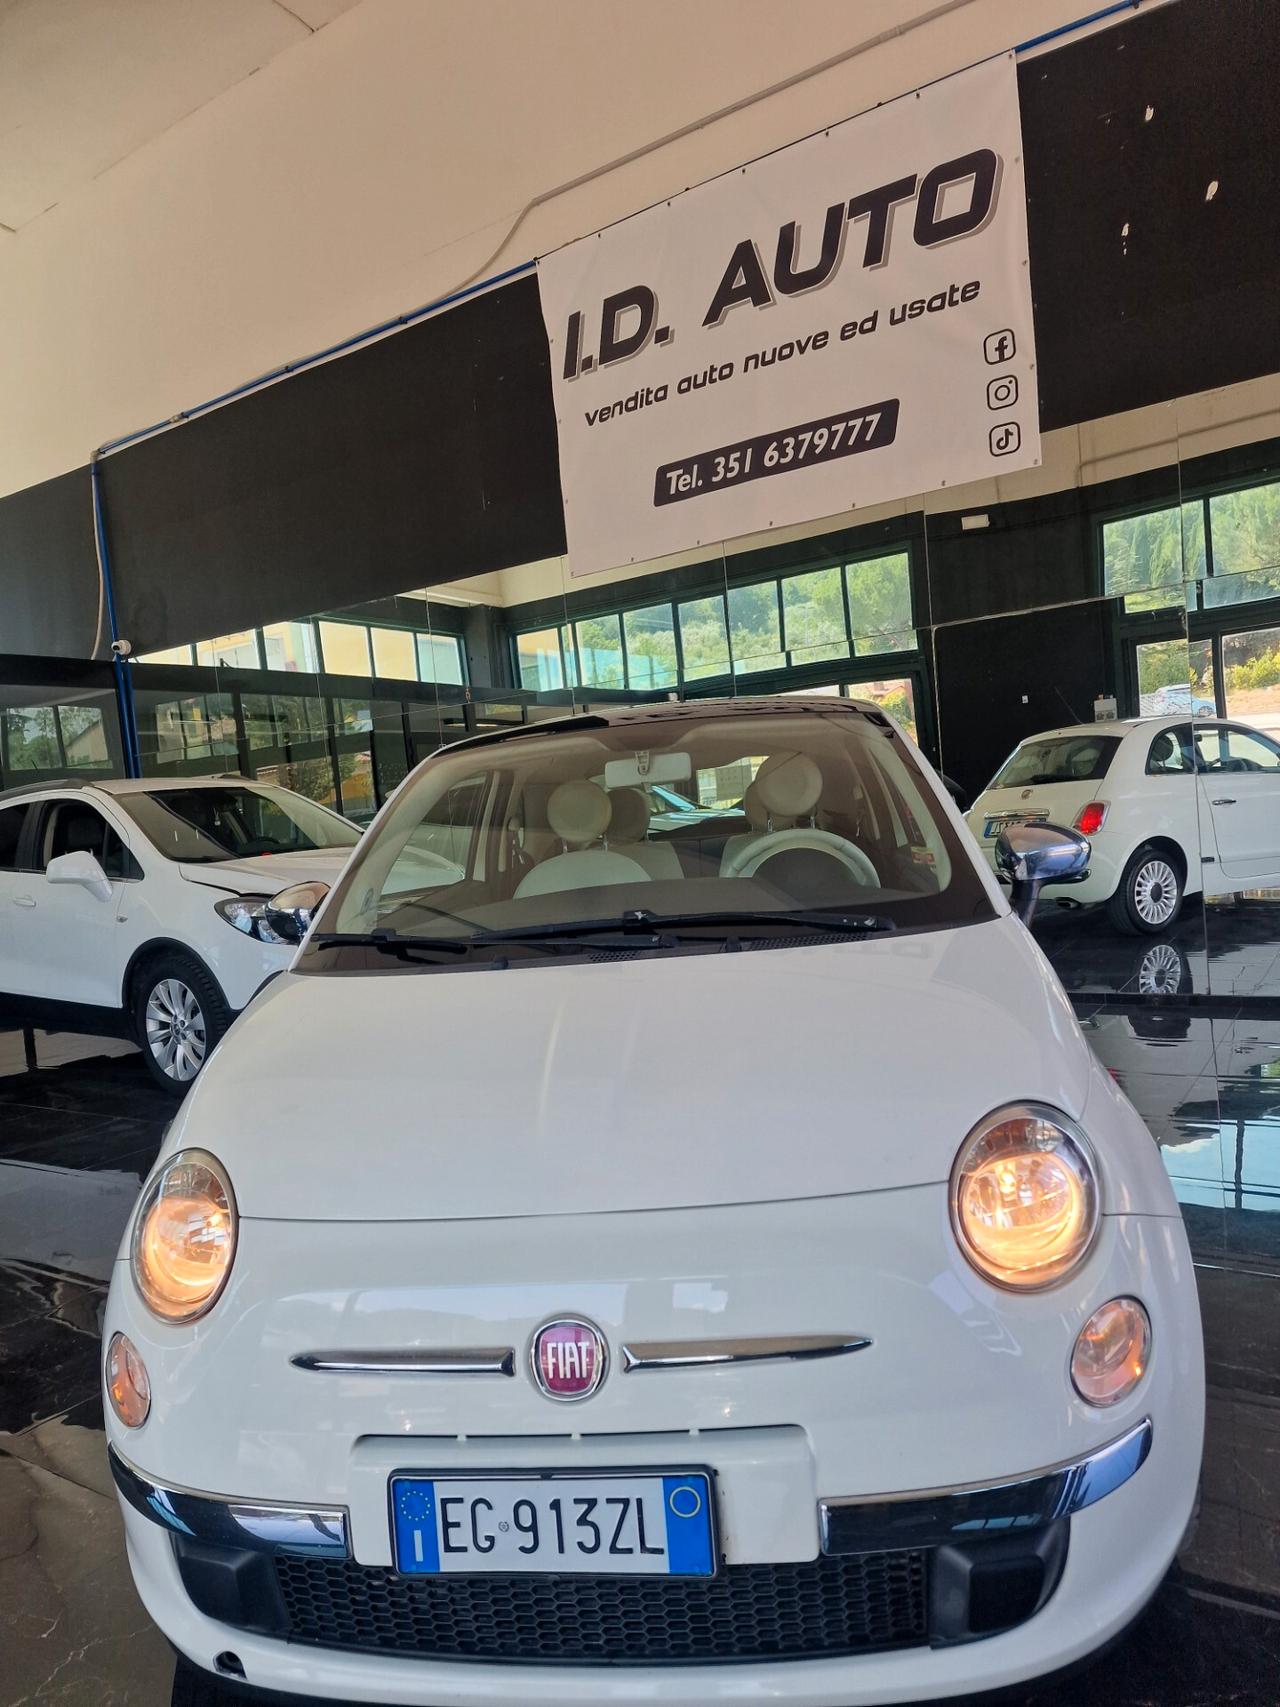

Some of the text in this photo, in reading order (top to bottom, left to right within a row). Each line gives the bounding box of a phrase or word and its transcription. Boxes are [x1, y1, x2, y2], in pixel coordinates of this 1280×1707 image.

[562, 148, 1004, 383] I.D. AUTO
[584, 280, 981, 427] vendita auto nuove ed usate
[666, 412, 883, 495] Tel. 351 6379777
[546, 1341, 590, 1379] FIAT
